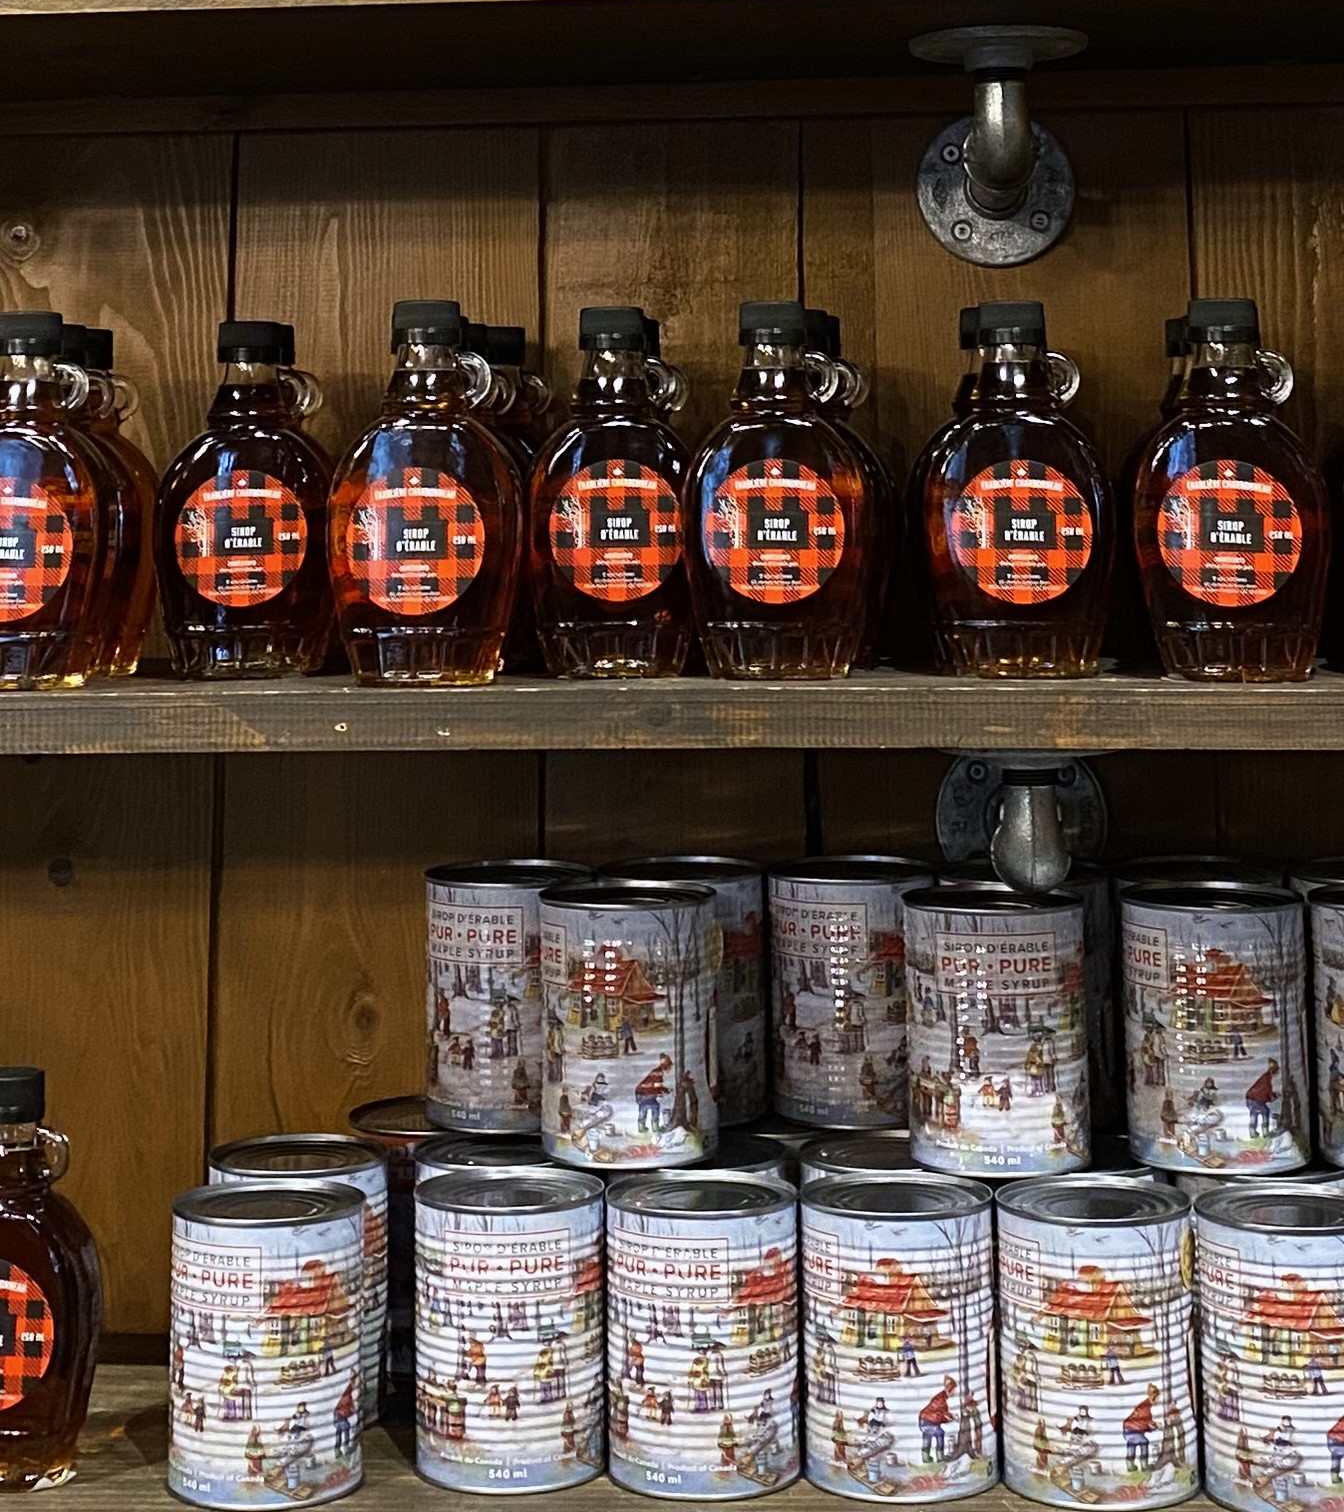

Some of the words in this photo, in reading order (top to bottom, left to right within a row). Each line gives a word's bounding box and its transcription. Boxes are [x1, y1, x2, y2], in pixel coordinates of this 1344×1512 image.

[607, 517, 632, 529] SIROP
[764, 518, 790, 530] SIROP
[1011, 518, 1037, 530] SIROP
[1217, 520, 1244, 532] SIROP
[231, 526, 255, 538] SIROP
[403, 528, 429, 540] SIROP
[601, 528, 638, 541] D'ÉRABLE
[757, 529, 797, 542] D'ÉRABLE
[1004, 529, 1045, 542] D'ÉRABLE
[1210, 531, 1251, 545] D'ÉRABLE
[225, 537, 262, 549] D'ÉRABLE
[396, 539, 435, 552] D'ÉRABLE
[467, 929, 517, 945] PURE
[468, 948, 514, 960] SYRUP
[999, 956, 1052, 974] PURE
[1002, 979, 1049, 991] SYRUP
[984, 1155, 1005, 1165] 540
[1008, 1155, 1022, 1165] ml
[510, 1256, 566, 1276] PURE
[663, 1264, 722, 1281] PURE
[201, 1270, 254, 1291] PURE
[512, 1278, 561, 1293] SYRUP
[665, 1284, 718, 1298] SYRUP
[202, 1293, 251, 1308] SYRUP
[488, 1468, 509, 1480] 540
[512, 1468, 528, 1479] ml
[646, 1469, 666, 1484] 540
[667, 1473, 682, 1485] ml
[183, 1477, 198, 1490] 540
[199, 1480, 211, 1493] ml
